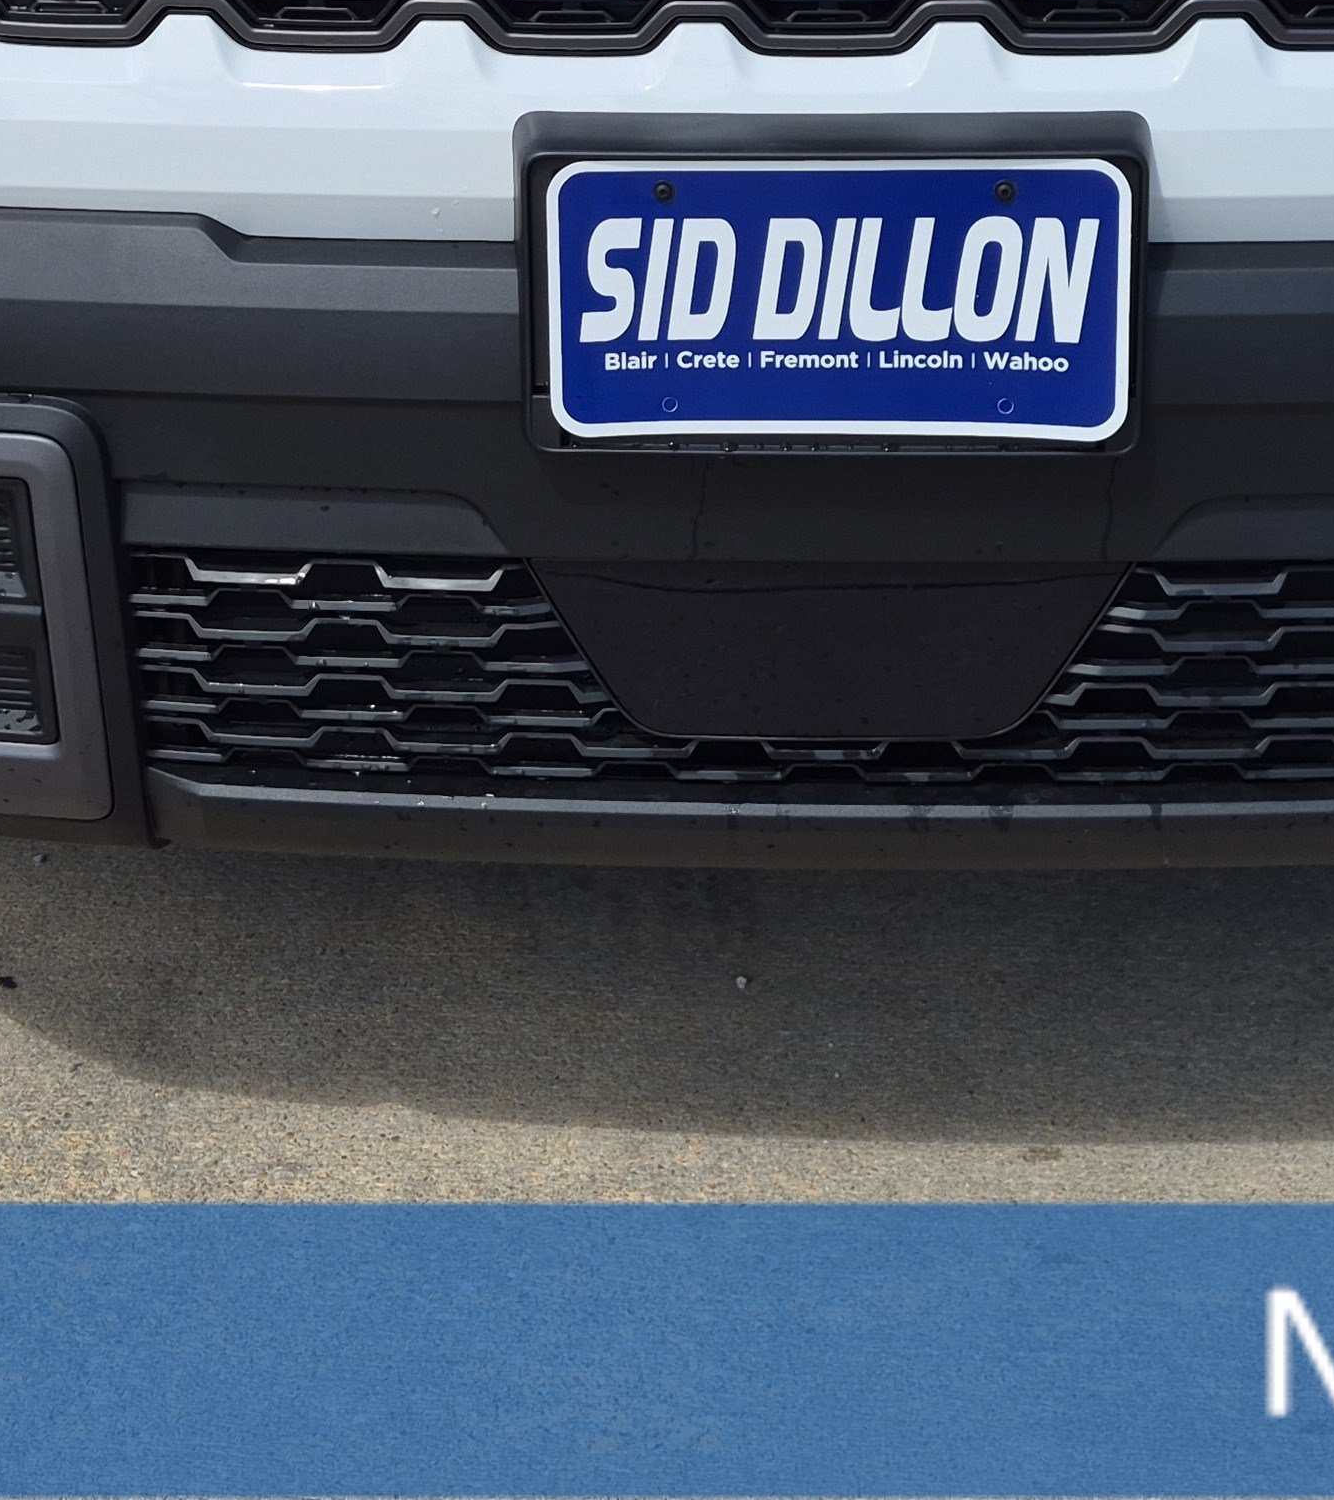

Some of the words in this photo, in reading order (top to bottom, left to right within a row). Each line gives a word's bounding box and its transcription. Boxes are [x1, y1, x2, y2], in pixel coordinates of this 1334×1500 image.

[579, 217, 737, 343] SID
[752, 215, 1100, 344] DILLON
[604, 351, 658, 371] Blair
[676, 350, 740, 369] Crete
[760, 350, 859, 369] Fremont
[879, 350, 963, 369] Lincoln
[983, 351, 1069, 373] Wahoo
